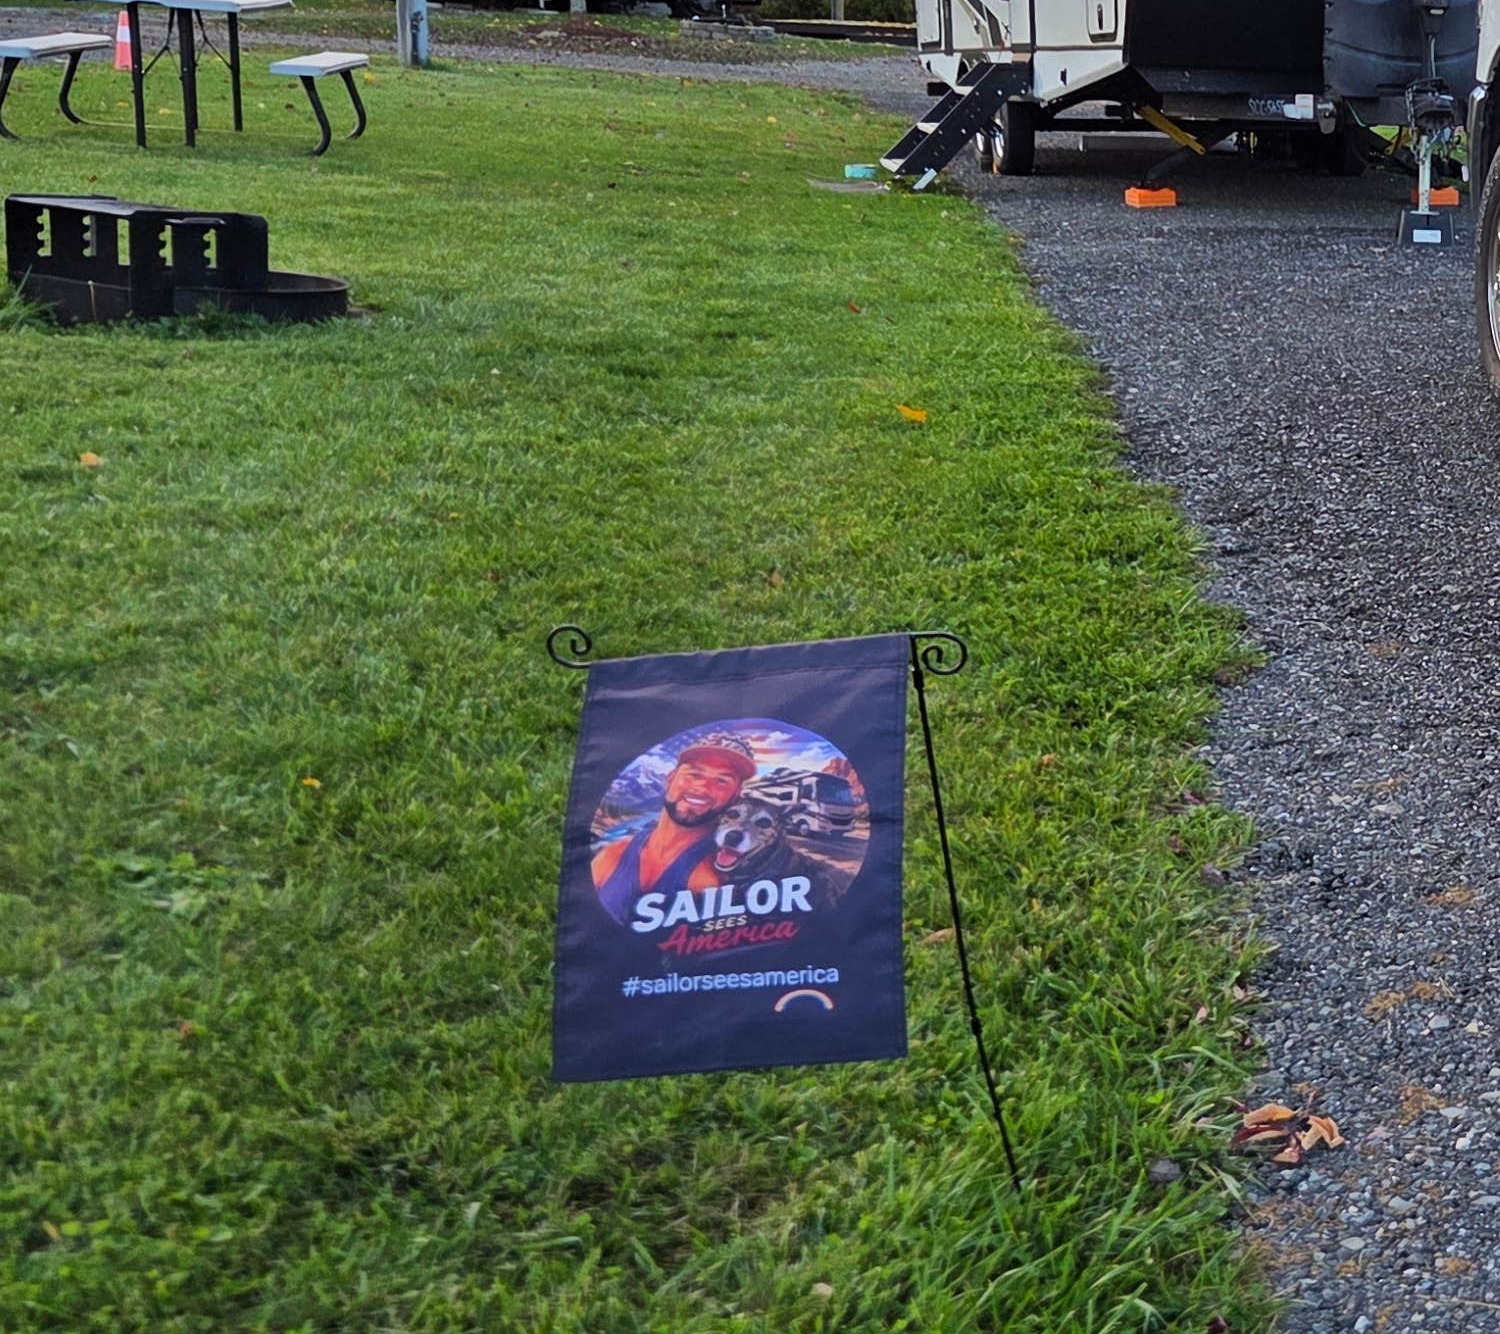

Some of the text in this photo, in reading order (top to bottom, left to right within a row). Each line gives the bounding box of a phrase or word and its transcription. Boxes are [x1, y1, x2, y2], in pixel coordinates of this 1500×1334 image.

[631, 875, 814, 933] SAILOR
[657, 919, 800, 956] America
[702, 915, 748, 932] SEES
[622, 965, 840, 998] #sailorseesamerica
